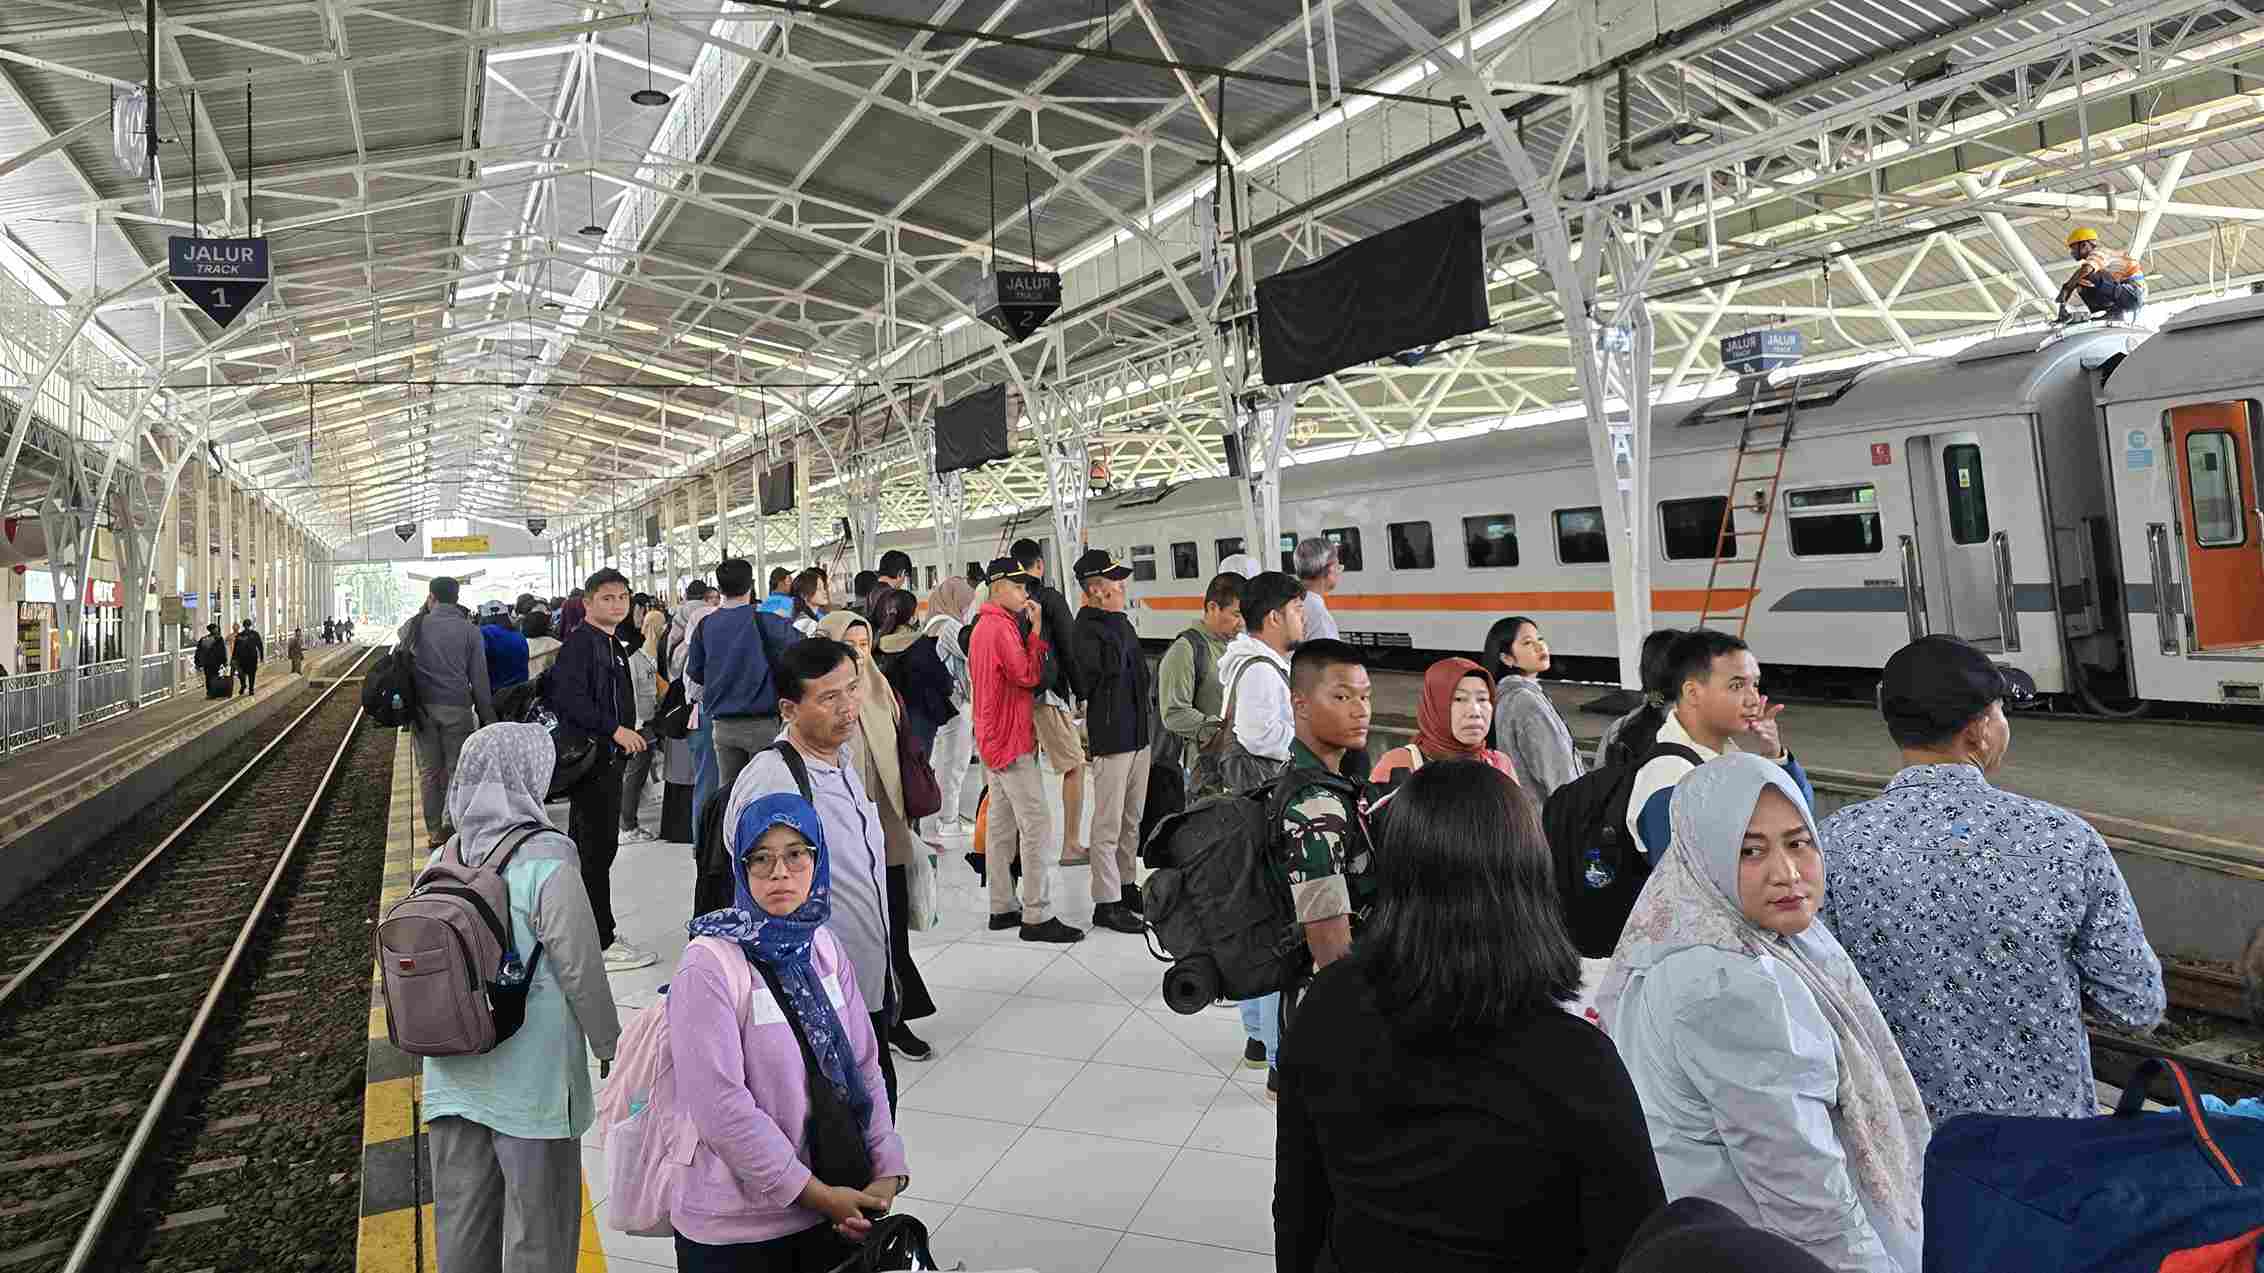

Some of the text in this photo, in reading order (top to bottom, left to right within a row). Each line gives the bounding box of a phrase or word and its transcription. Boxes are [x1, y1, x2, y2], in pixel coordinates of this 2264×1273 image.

[183, 245, 254, 262] JALUR
[197, 263, 240, 274] TRACK
[1008, 277, 1051, 291] JALUR
[211, 287, 232, 308] 1
[1020, 311, 1034, 327] 2
[1726, 335, 1756, 353] JALUR
[1767, 334, 1796, 346] JALUR
